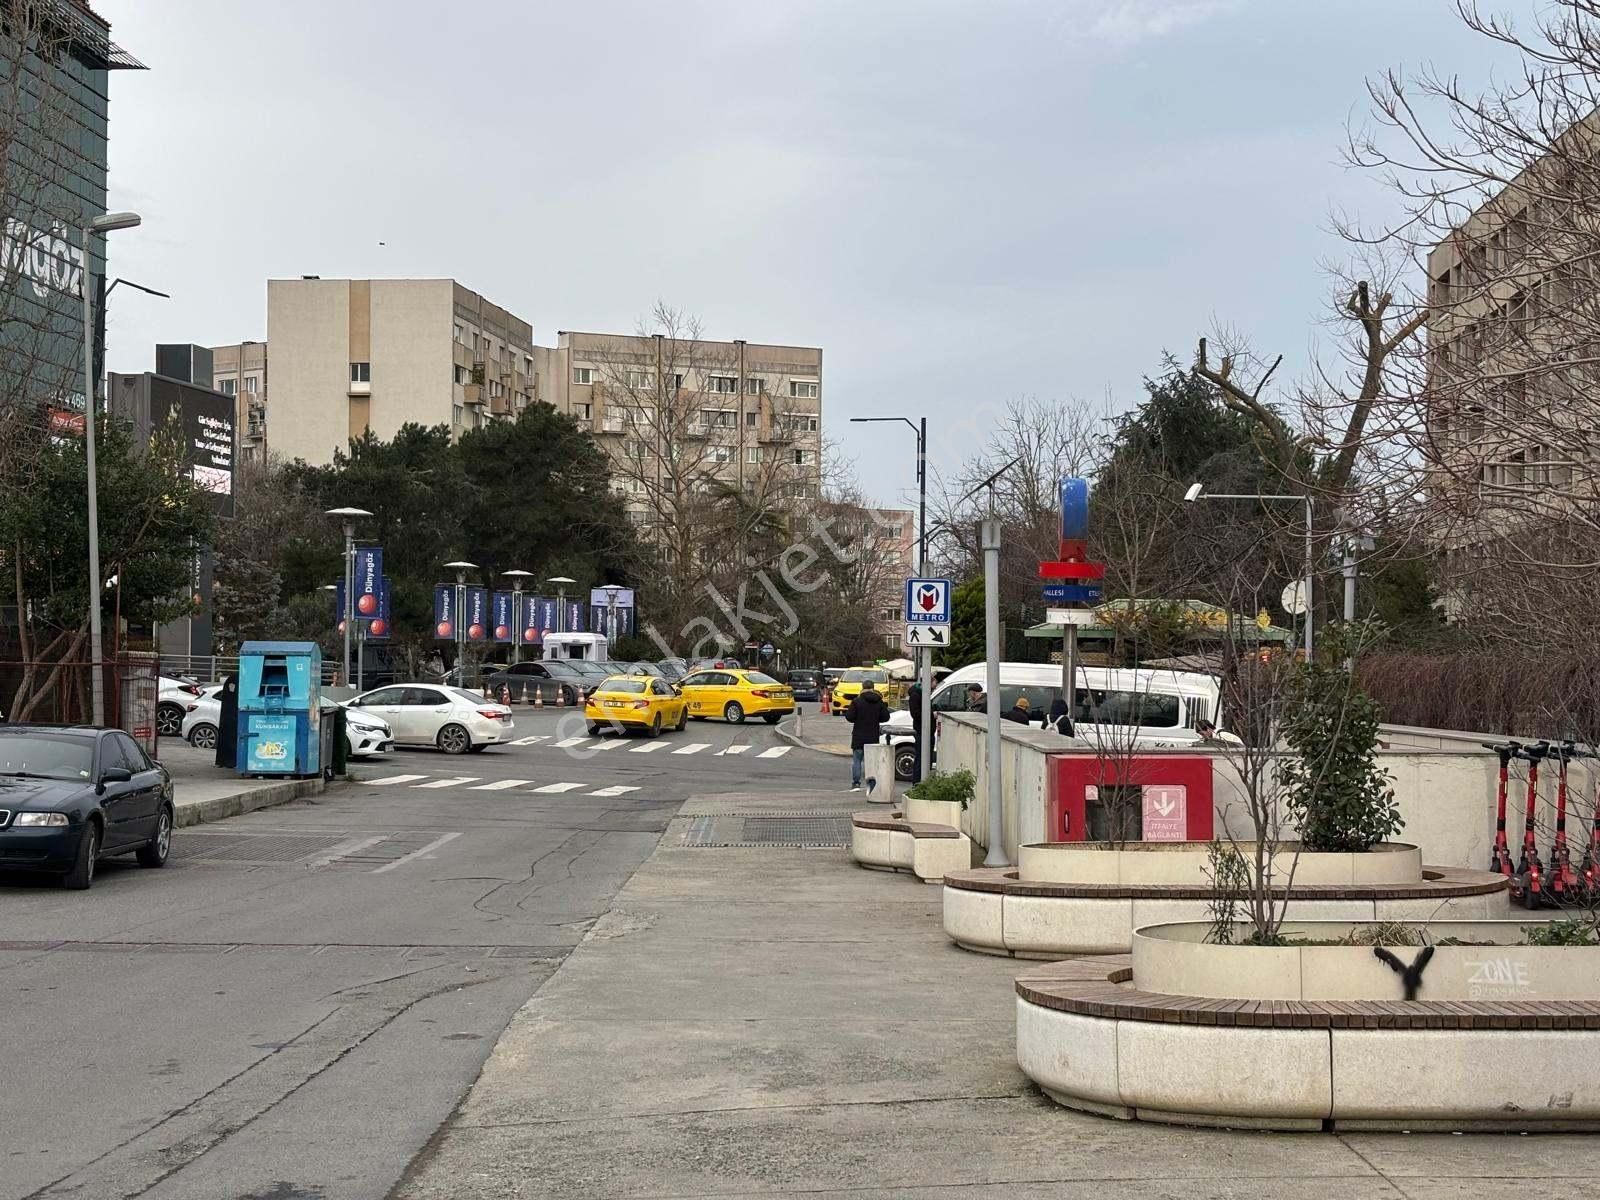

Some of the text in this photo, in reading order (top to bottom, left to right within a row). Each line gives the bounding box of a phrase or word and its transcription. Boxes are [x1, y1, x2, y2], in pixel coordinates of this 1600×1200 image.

[365, 552, 375, 593] Dünyagöz
[473, 592, 481, 624] Dünyagöz
[499, 596, 507, 625] Dünyagöz
[1463, 957, 1531, 985] ZONE
